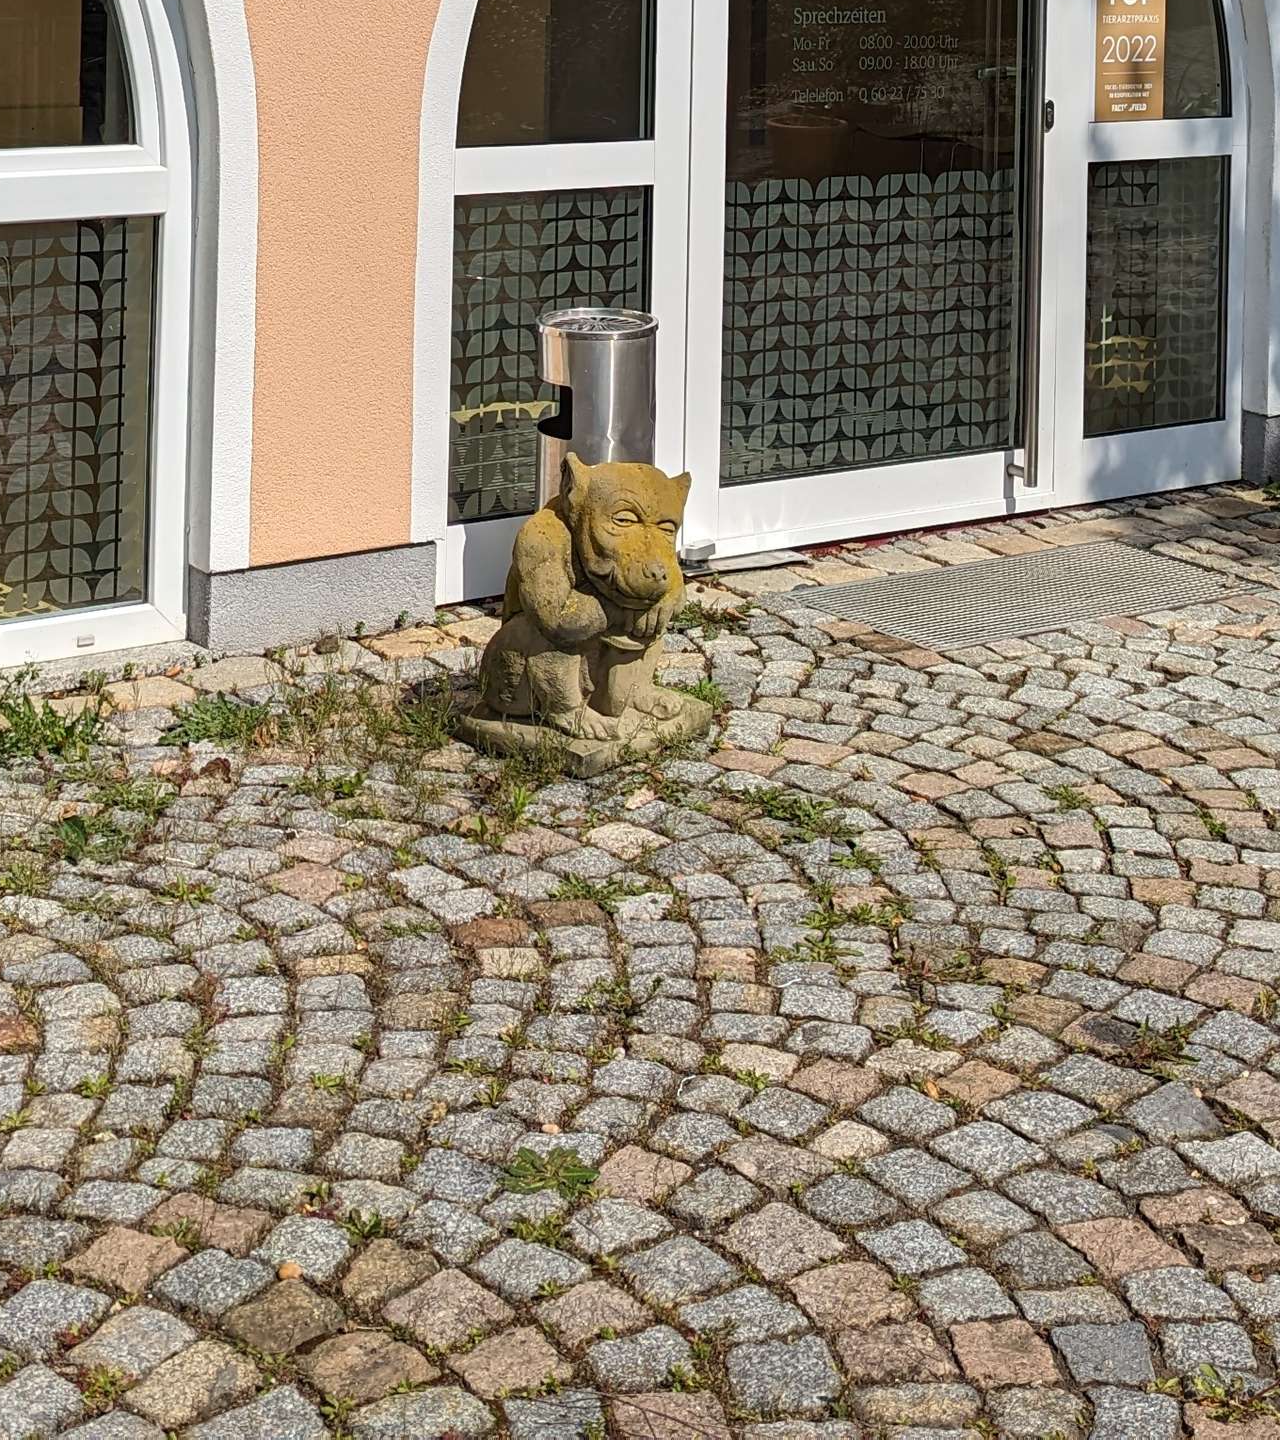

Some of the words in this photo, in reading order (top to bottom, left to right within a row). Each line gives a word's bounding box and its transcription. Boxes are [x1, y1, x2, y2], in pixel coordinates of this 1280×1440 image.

[793, 6, 887, 28] Sprechzeiten
[1102, 14, 1160, 24] TIERARZTPRAXIS
[938, 34, 960, 49] Uhr
[1102, 35, 1157, 64] 2022
[938, 55, 960, 69] Uhr
